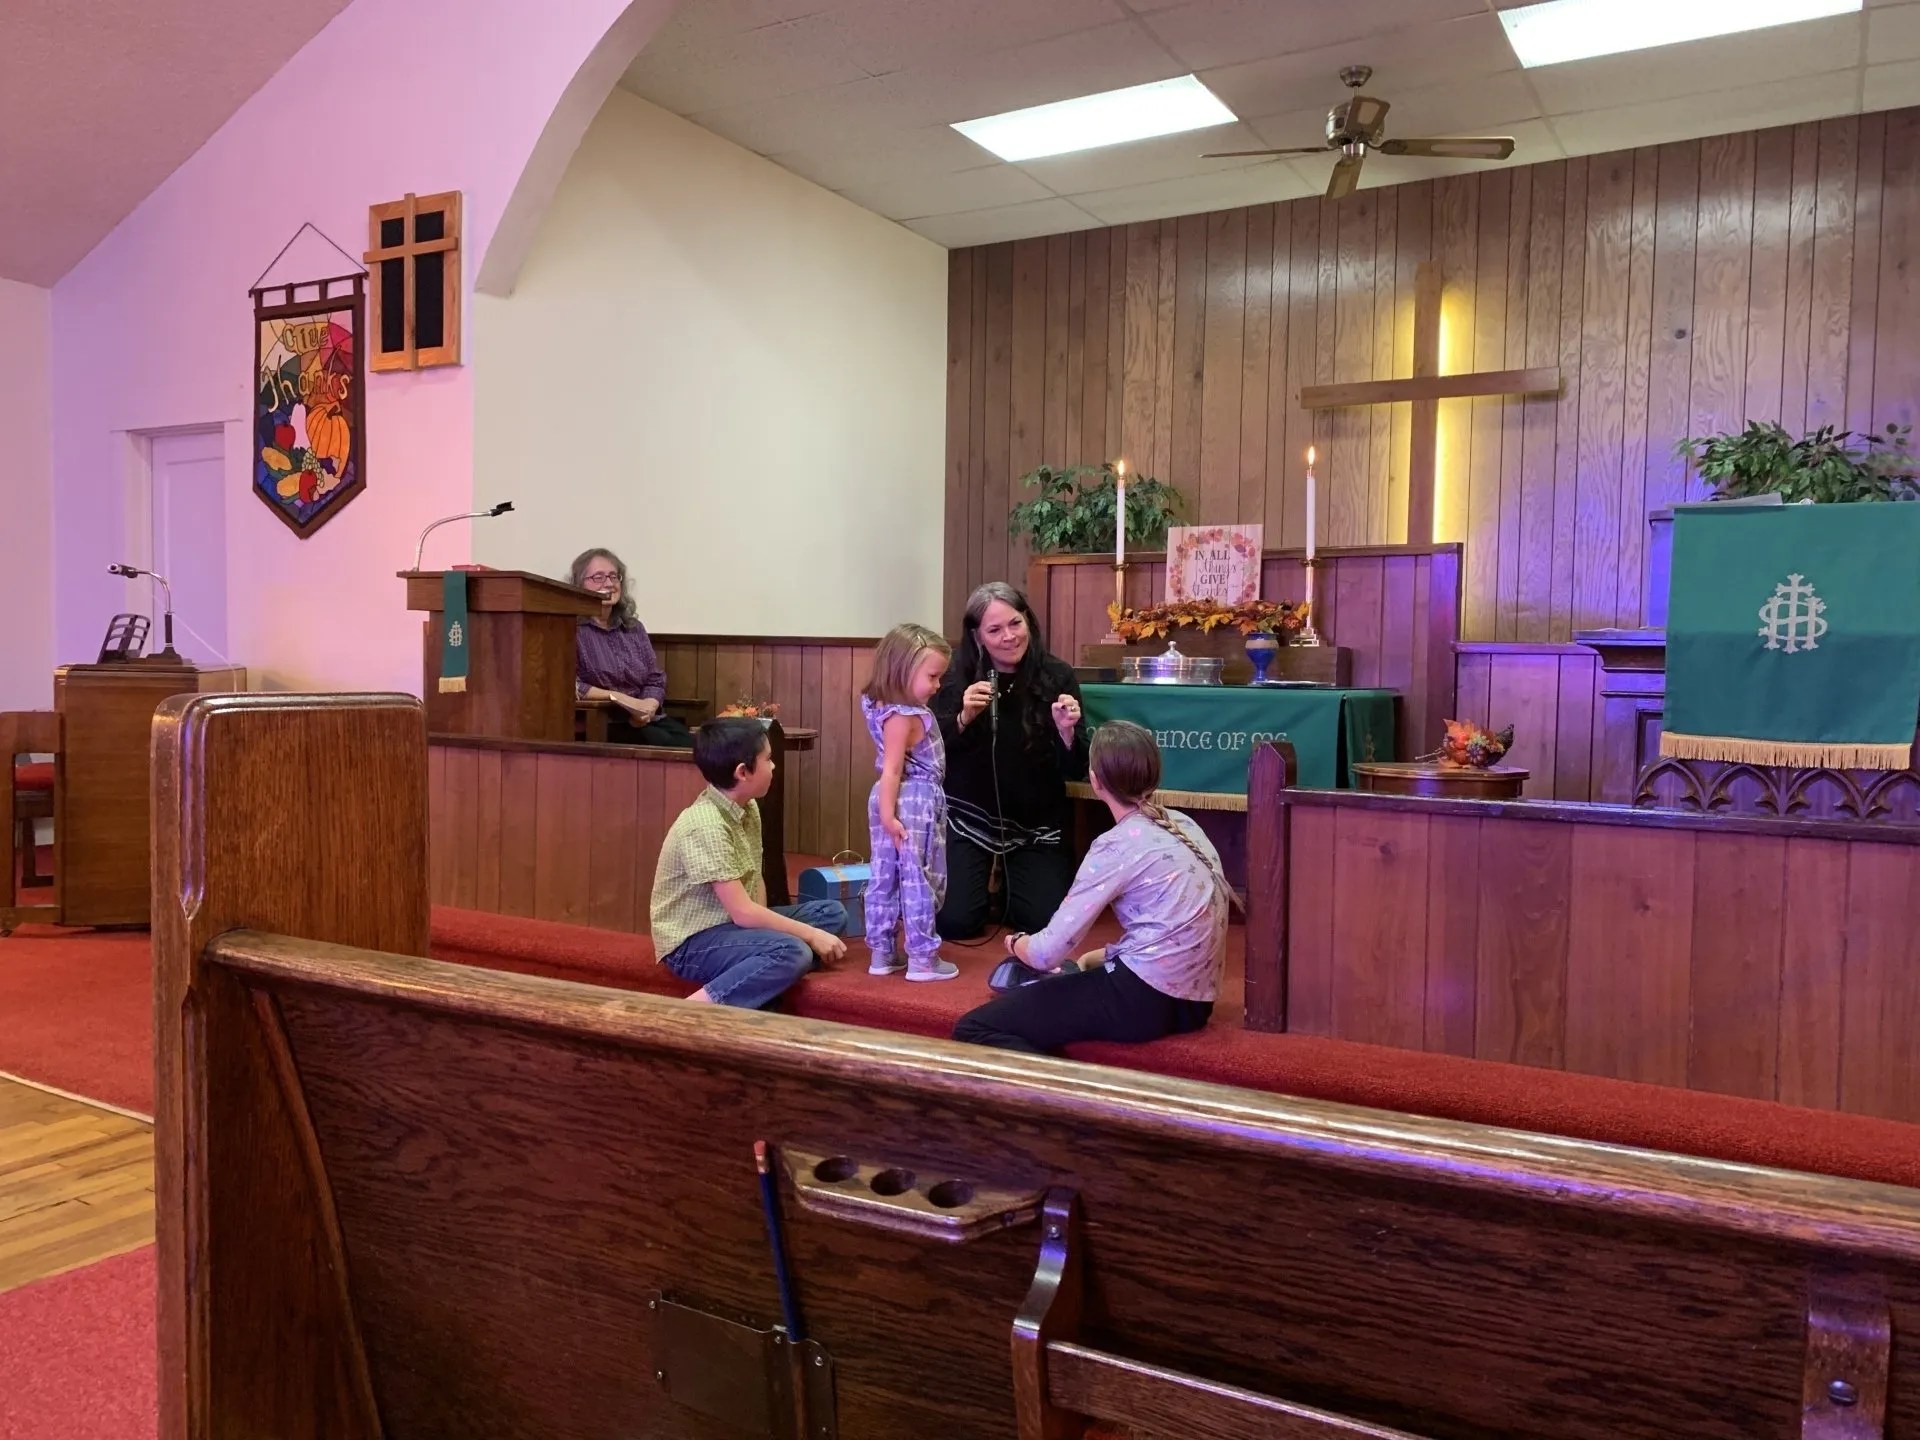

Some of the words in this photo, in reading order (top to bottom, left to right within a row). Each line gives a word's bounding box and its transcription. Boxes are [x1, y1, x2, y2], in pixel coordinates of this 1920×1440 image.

[260, 344, 350, 413] Thanks
[1195, 550, 1204, 560] IN
[1210, 550, 1230, 560] ALL
[1200, 574, 1225, 584] GIVE
[1217, 731, 1247, 750] OF
